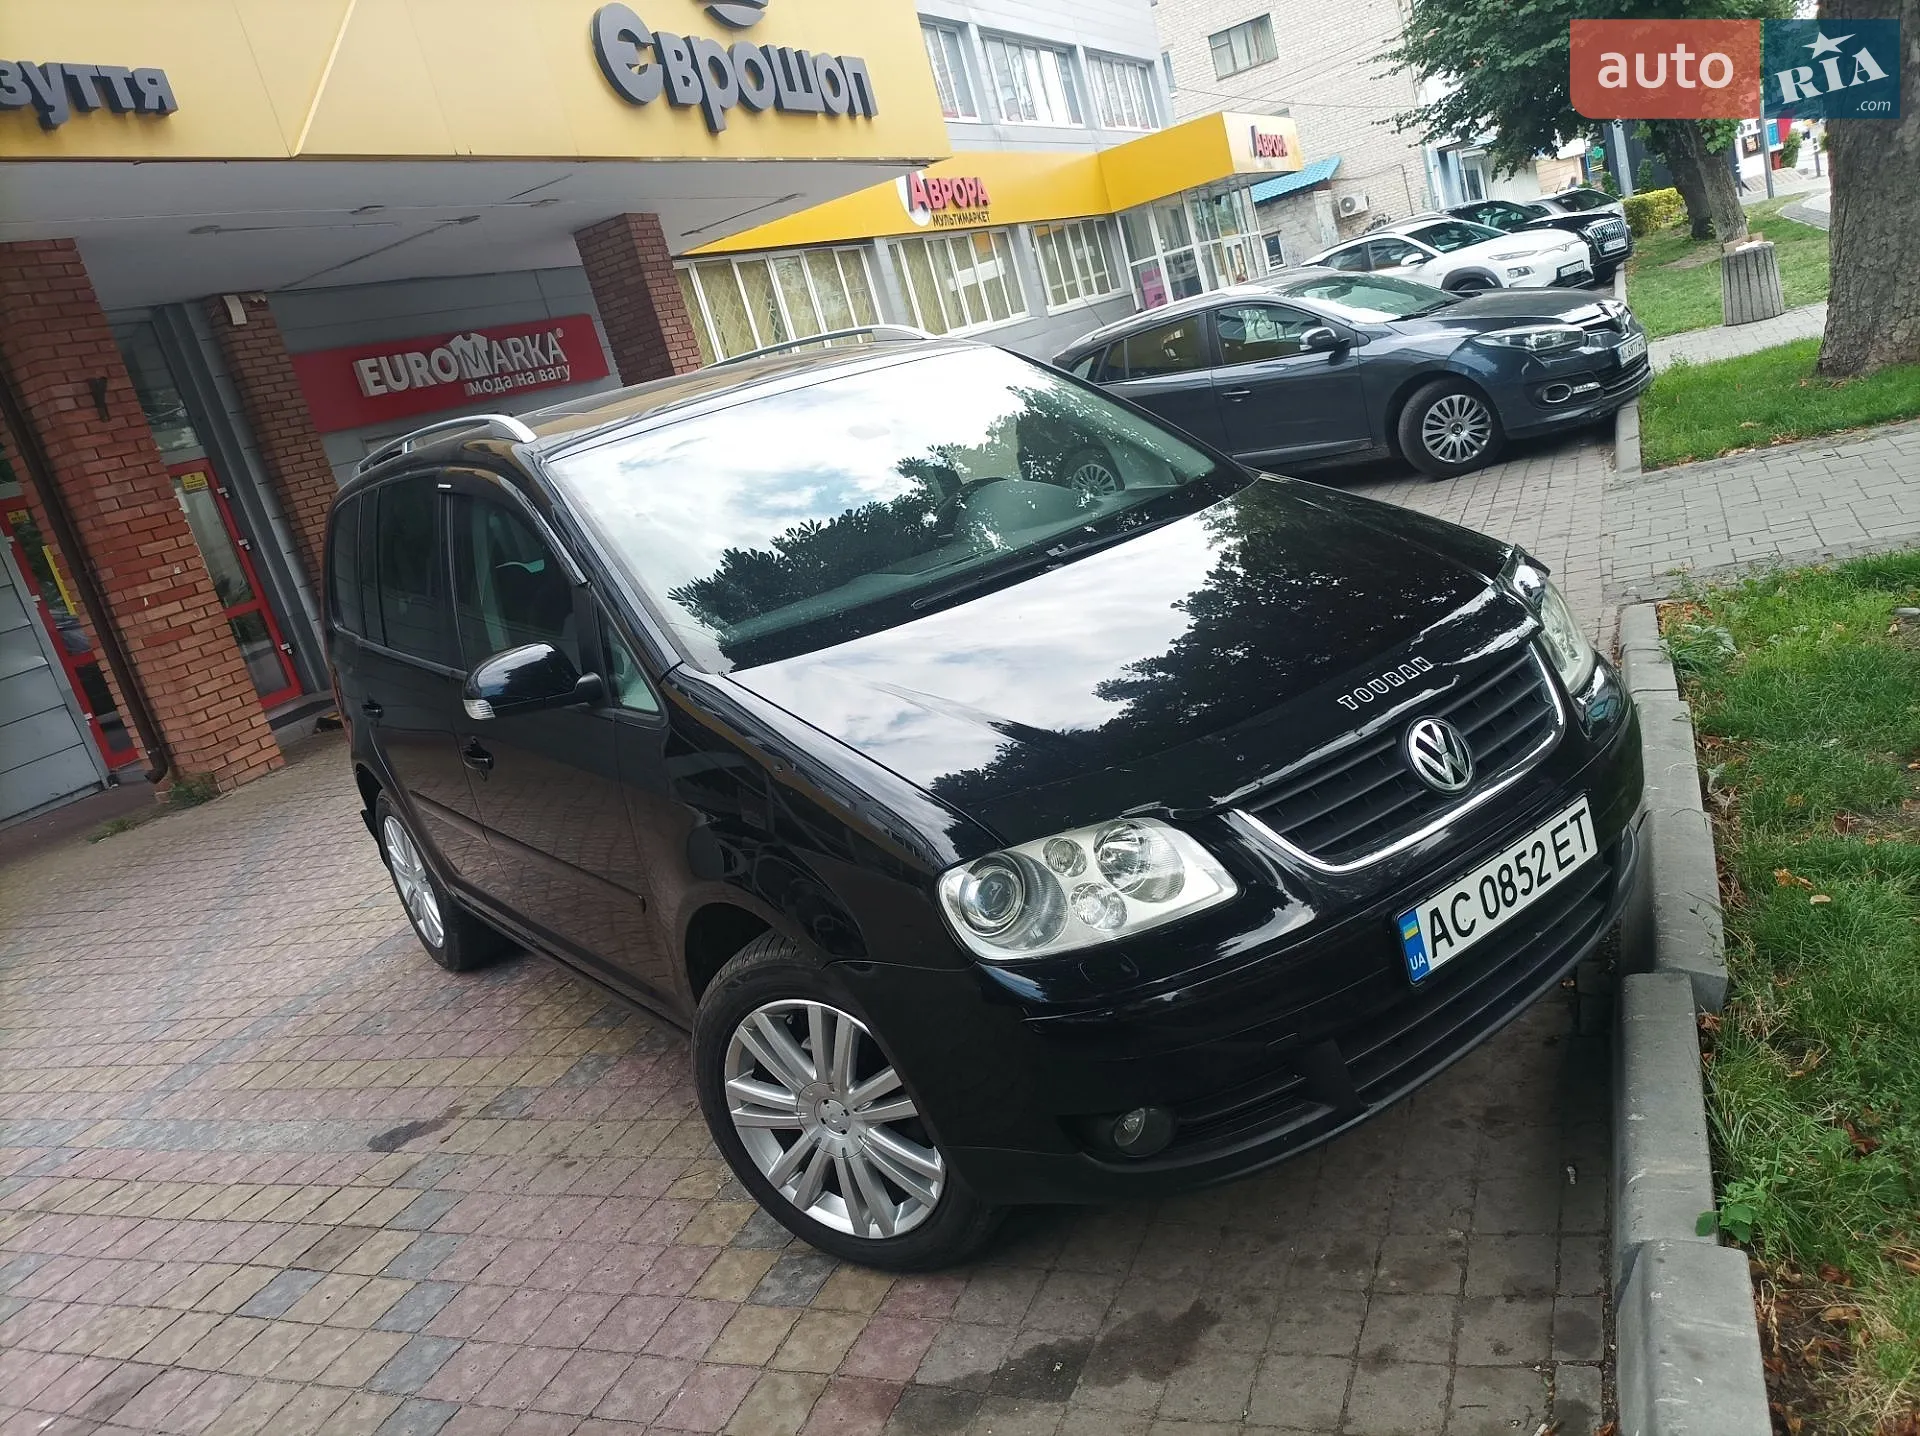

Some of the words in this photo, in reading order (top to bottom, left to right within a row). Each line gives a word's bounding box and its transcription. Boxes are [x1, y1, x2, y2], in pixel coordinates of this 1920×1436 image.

[592, 2, 878, 135] Єврошоп
[1251, 125, 1288, 158] АВРОРА
[906, 171, 991, 213] АВРОРА
[932, 210, 991, 228] МУЛЬТИМАРКЕТ
[465, 375, 513, 397] мода
[516, 371, 538, 386] на
[540, 364, 571, 384] вагу
[1337, 656, 1434, 711] TOURAN
[1427, 890, 1477, 960] AC
[1478, 839, 1552, 921] 0852
[1550, 806, 1589, 873] ET
[1410, 951, 1427, 971] UA
